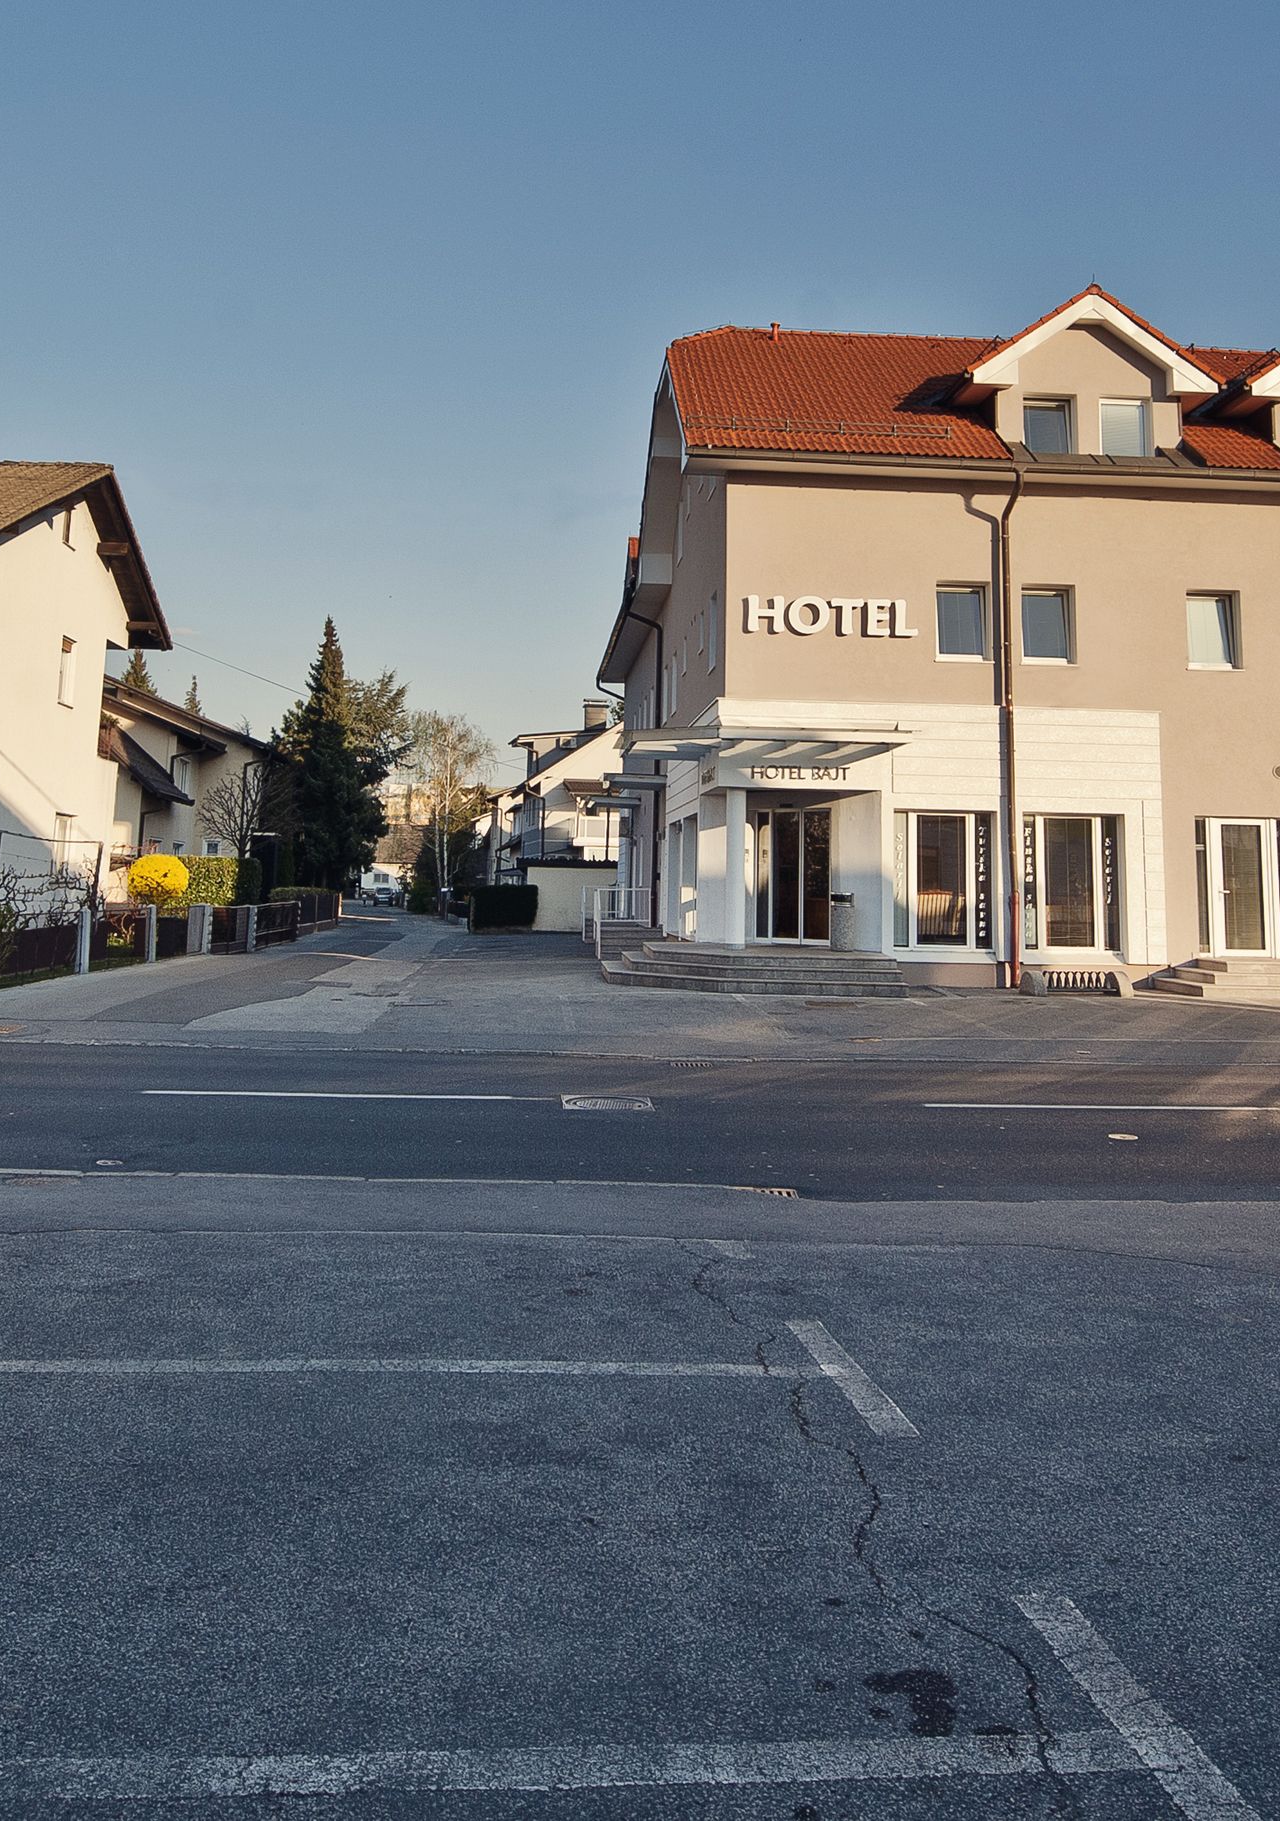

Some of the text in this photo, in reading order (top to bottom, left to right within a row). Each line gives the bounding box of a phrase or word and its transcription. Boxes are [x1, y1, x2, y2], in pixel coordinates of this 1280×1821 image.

[745, 594, 919, 638] HOTEL
[750, 765, 851, 781] HOTEL BAJT
